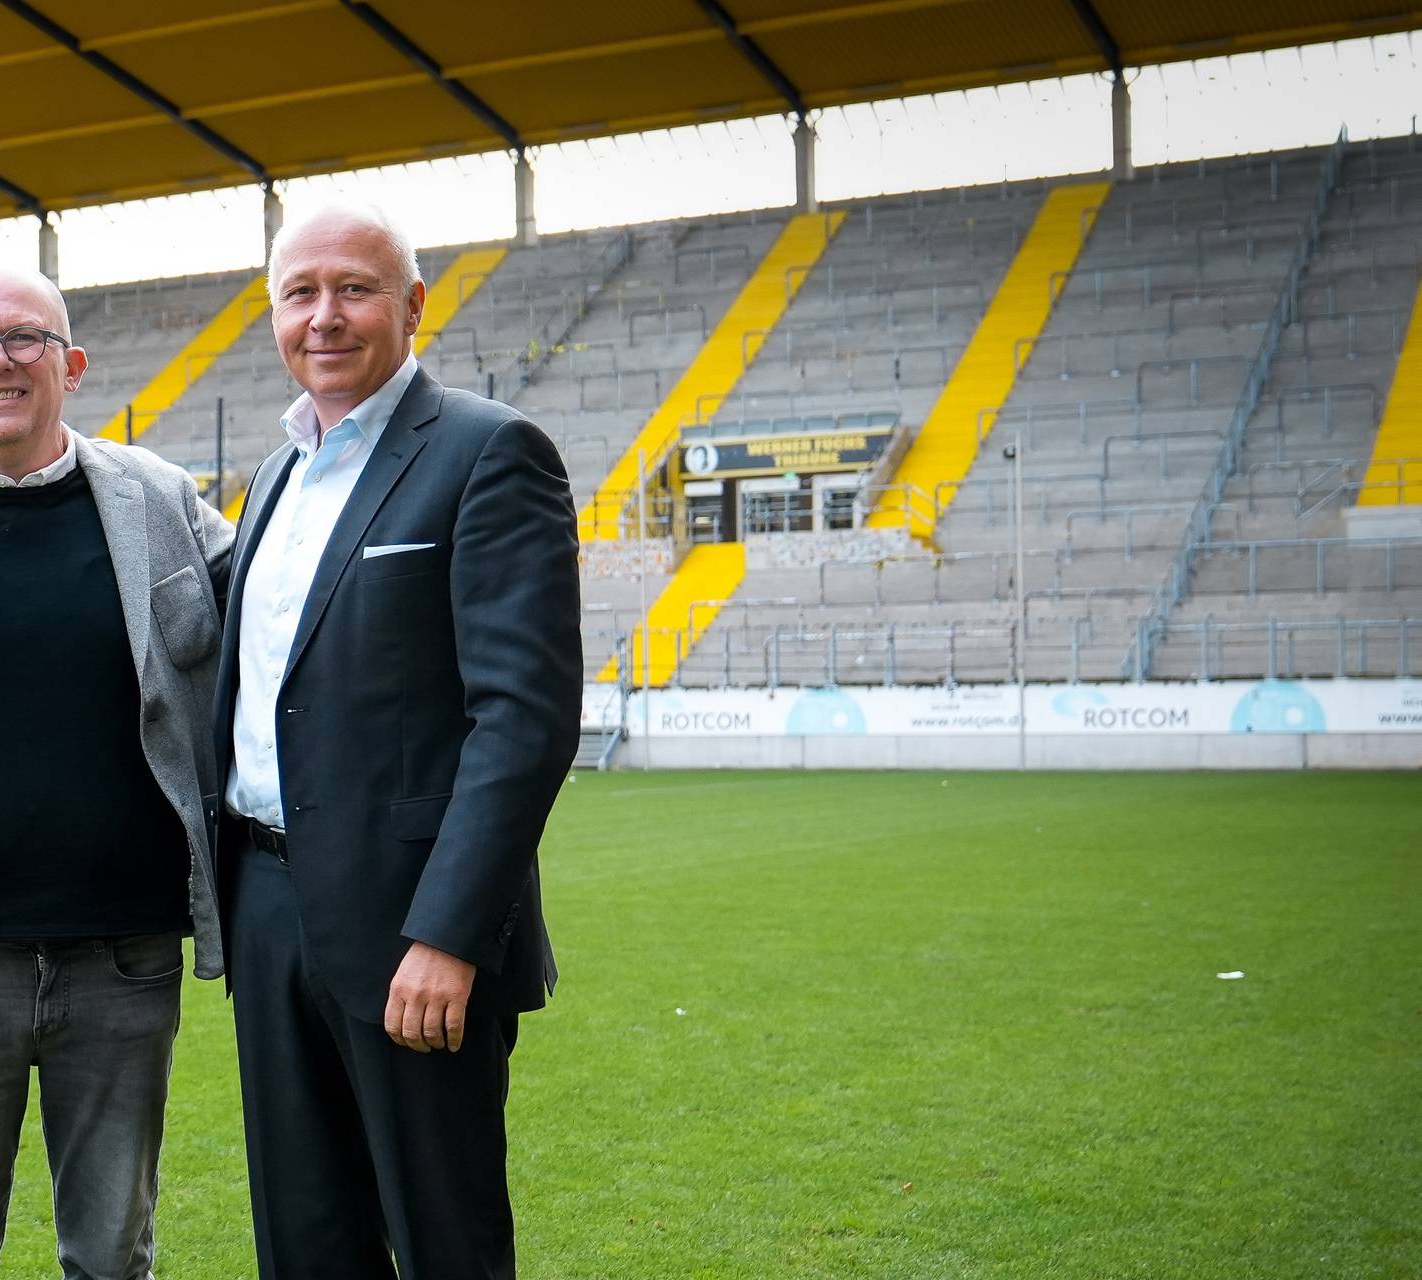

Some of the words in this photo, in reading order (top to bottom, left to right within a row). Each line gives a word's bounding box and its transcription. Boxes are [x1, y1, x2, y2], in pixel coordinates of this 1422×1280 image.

[747, 438, 812, 455] WERNER
[814, 436, 867, 451] FUCHS
[661, 712, 752, 730] ROTCOM
[1083, 708, 1190, 728] ROTCOM
